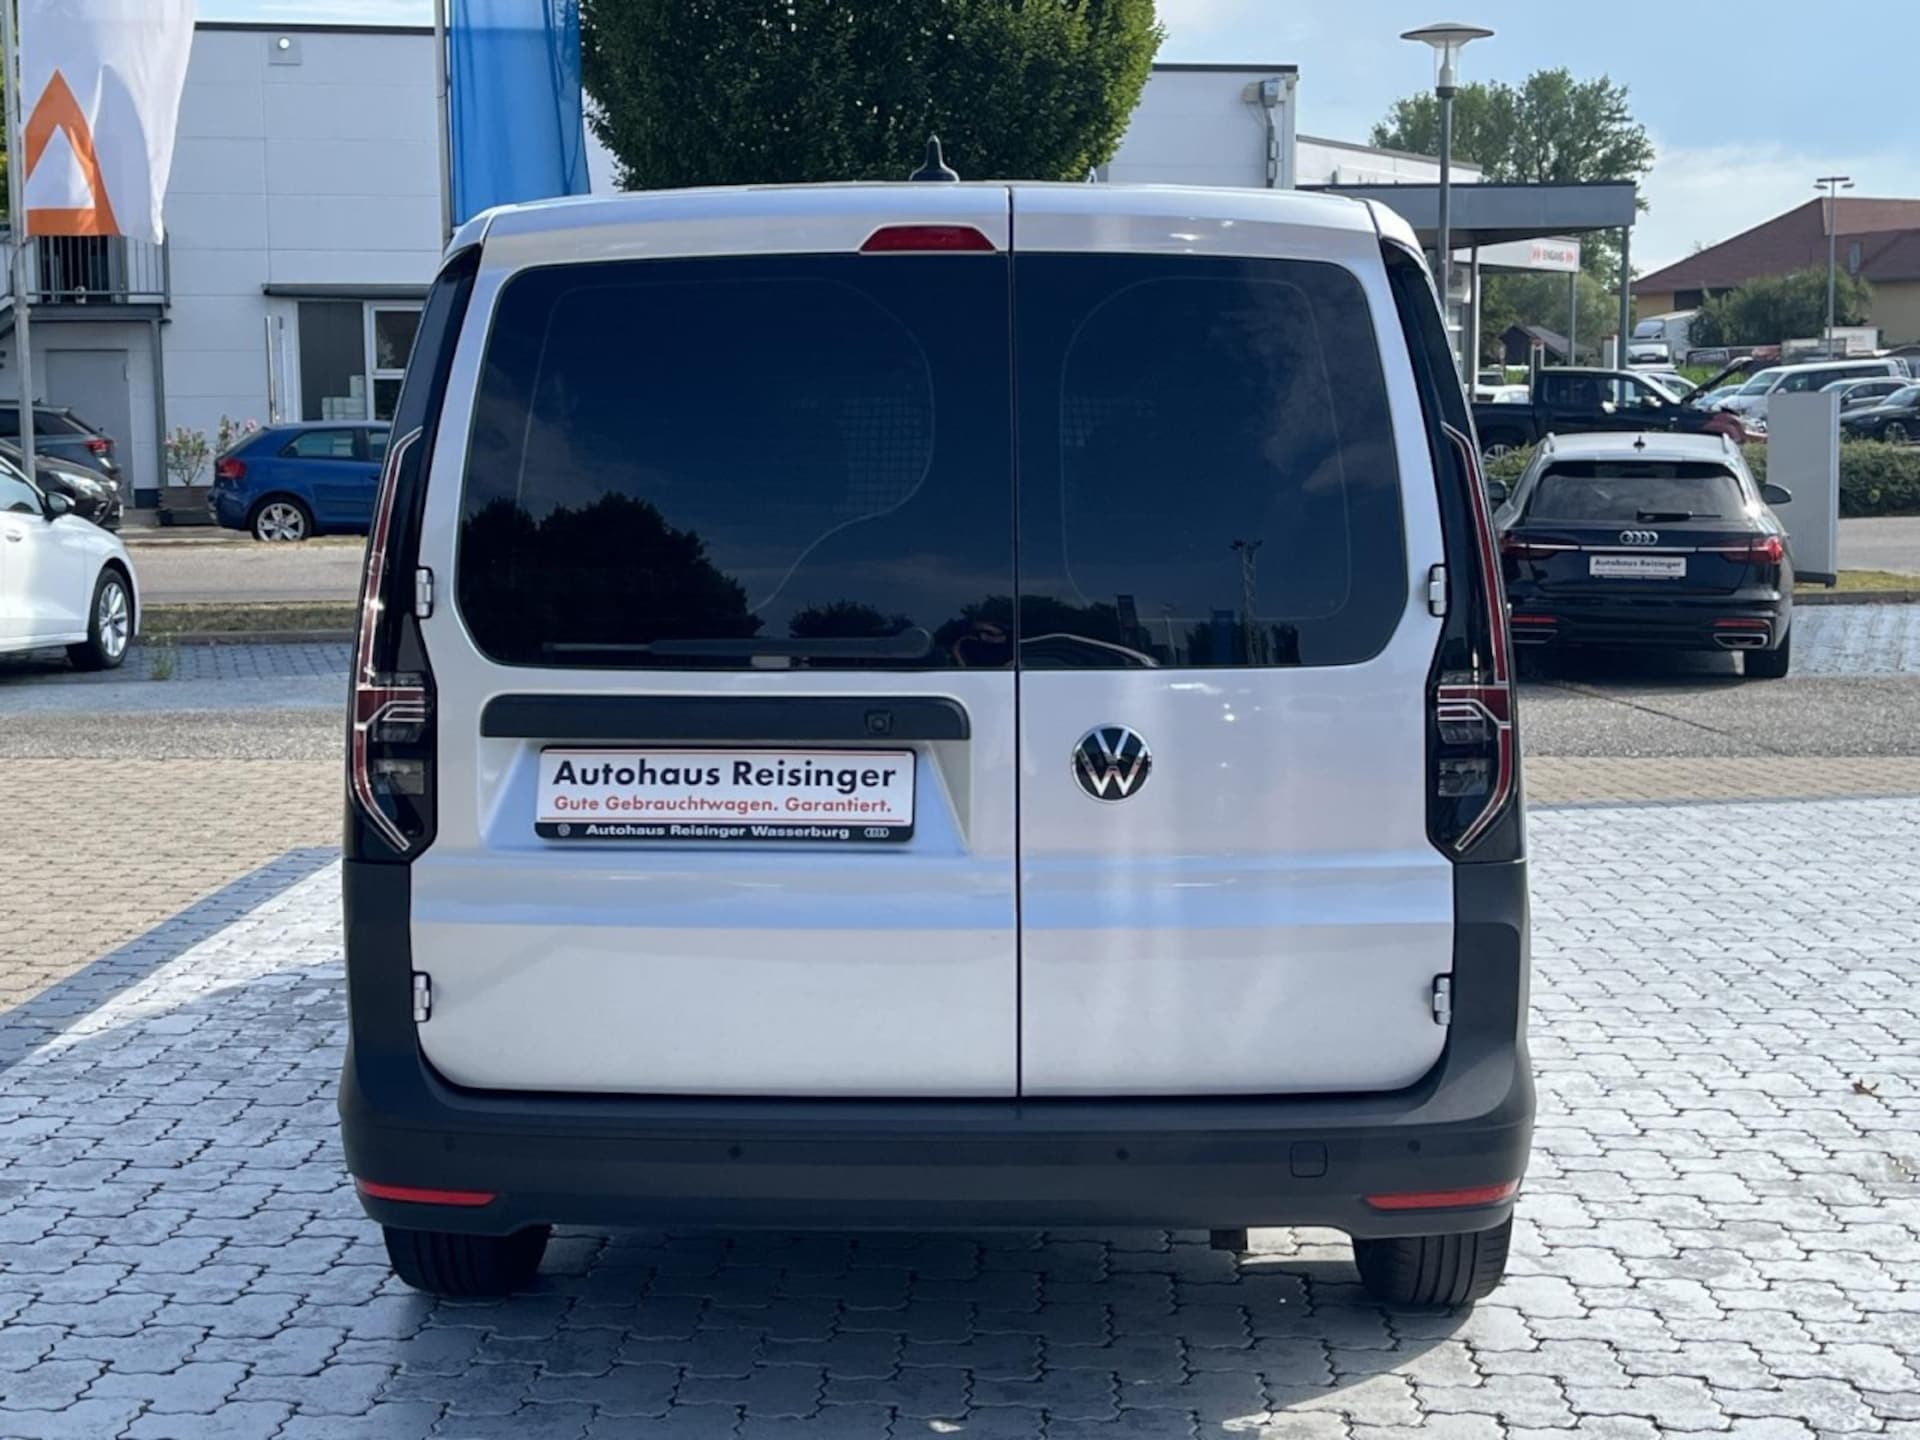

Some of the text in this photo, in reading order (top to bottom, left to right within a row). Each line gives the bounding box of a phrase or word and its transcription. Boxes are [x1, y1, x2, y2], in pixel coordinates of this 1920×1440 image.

[552, 758, 896, 794] Autohaus Reisinger
[554, 795, 892, 815] Gute Gebrauchtwagen. Garantiert.
[585, 824, 850, 839] Autohaus Reisinger Wasserburg
